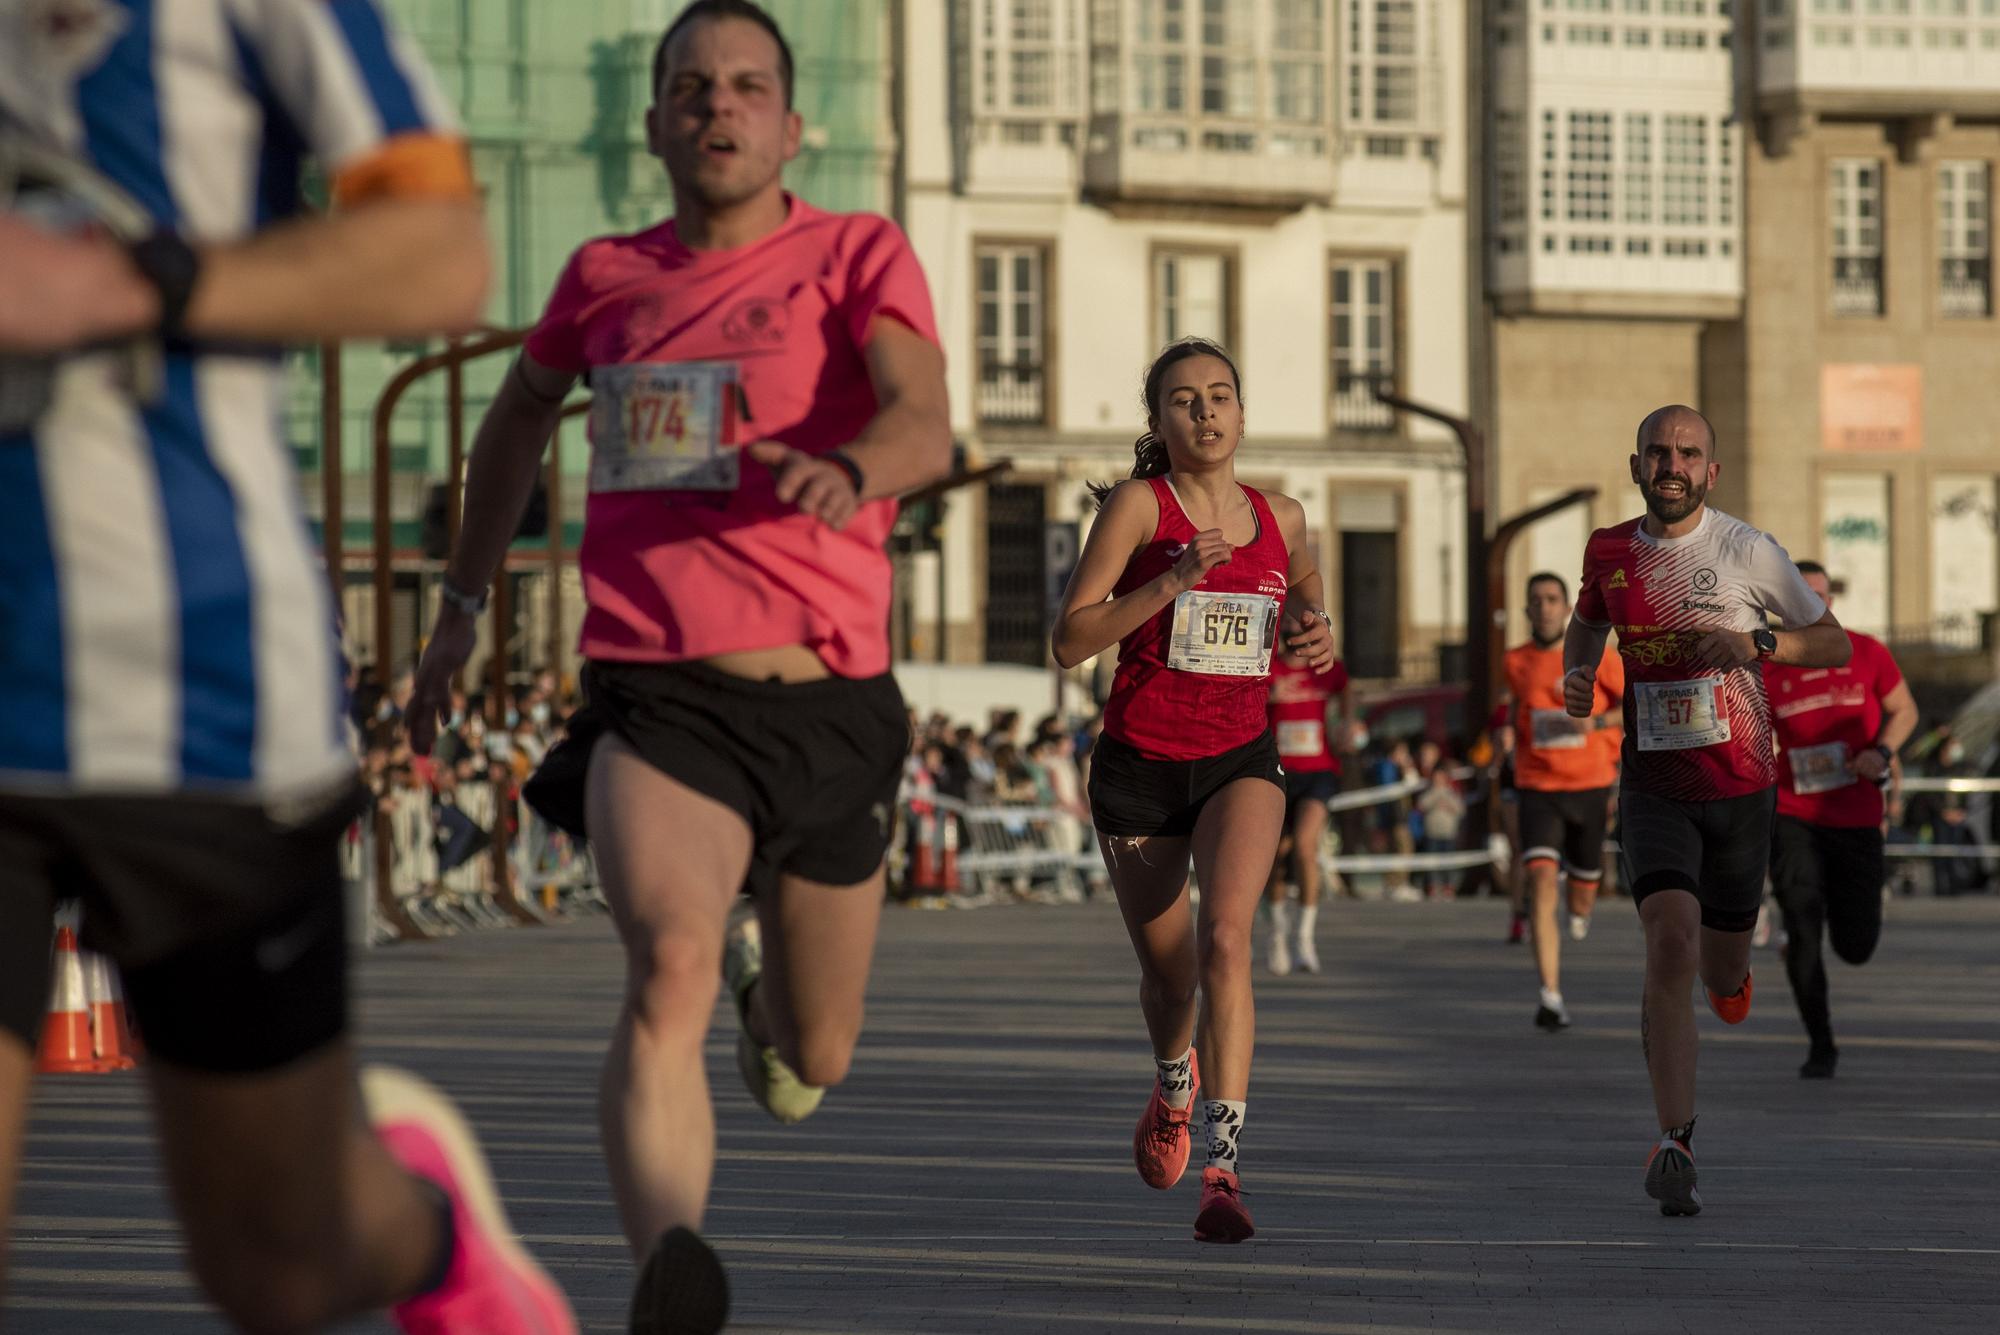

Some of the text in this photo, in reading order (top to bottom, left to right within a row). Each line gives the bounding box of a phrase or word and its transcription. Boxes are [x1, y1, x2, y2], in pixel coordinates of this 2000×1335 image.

[630, 399, 686, 446] 174
[1215, 602, 1243, 613] IREA
[1204, 614, 1248, 645] 676
[1667, 699, 1692, 725] 57
